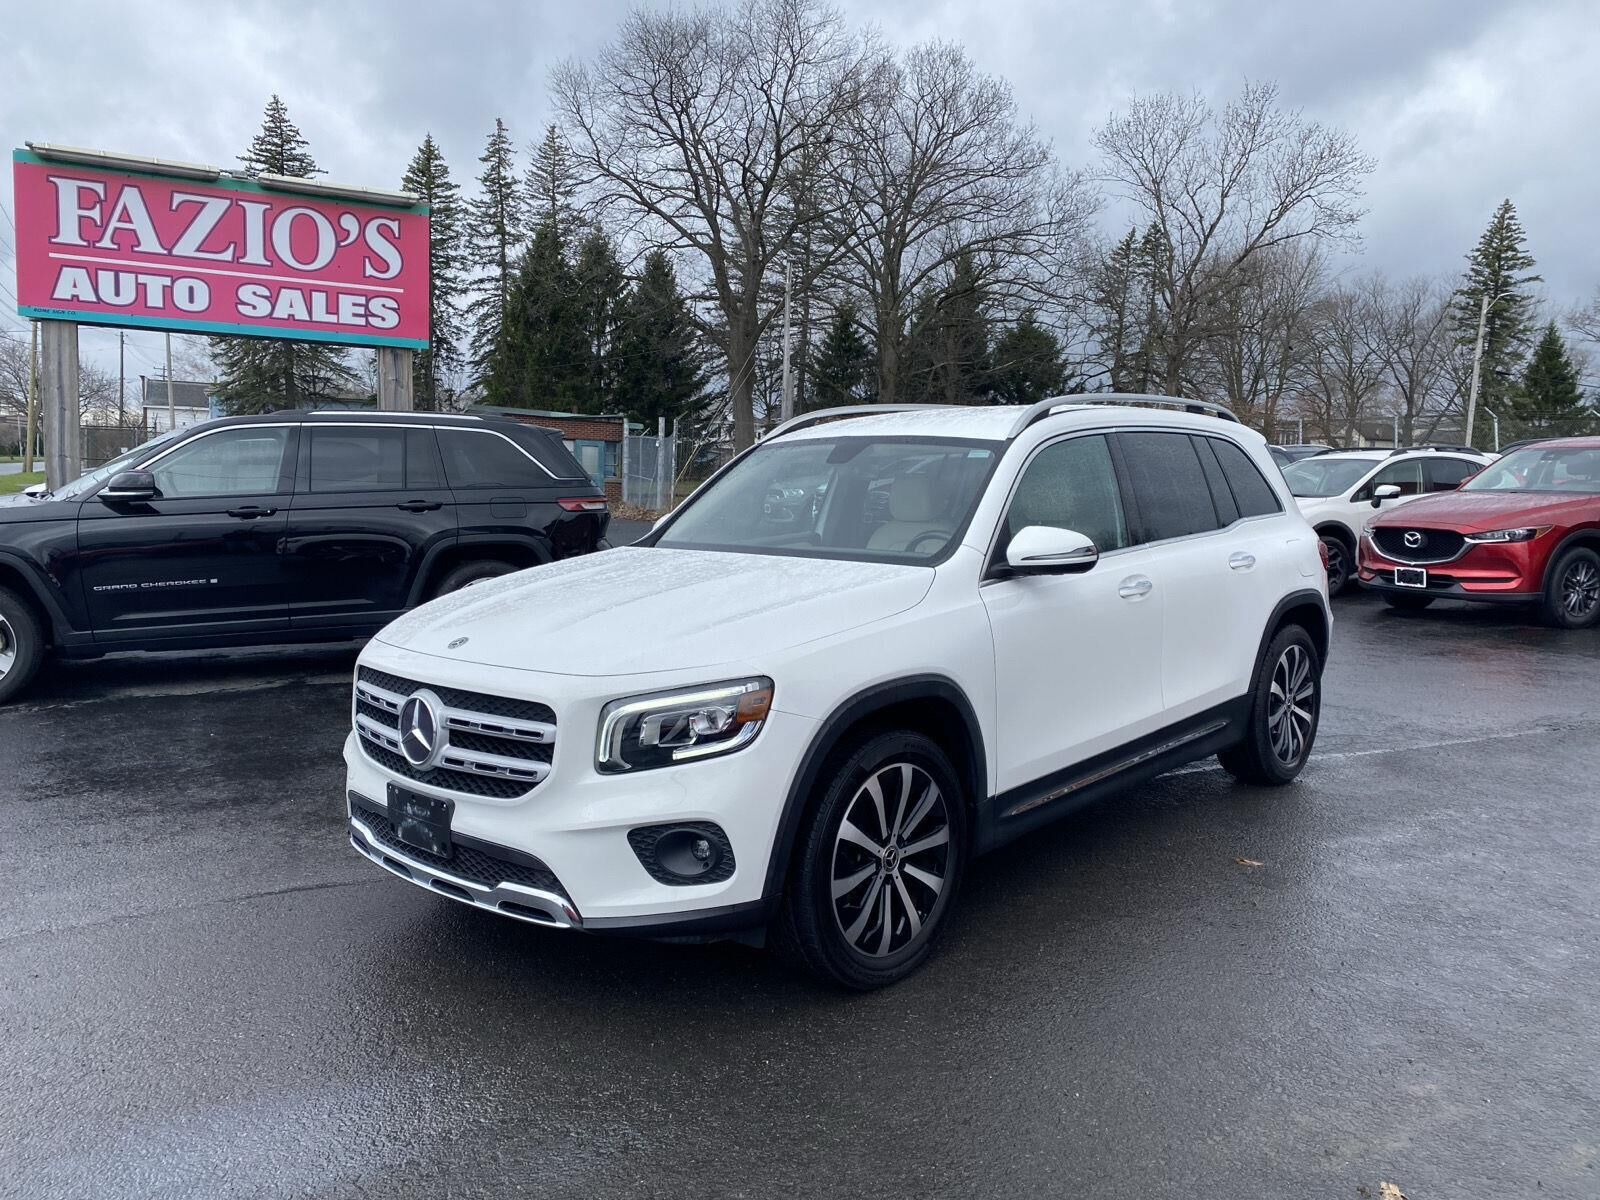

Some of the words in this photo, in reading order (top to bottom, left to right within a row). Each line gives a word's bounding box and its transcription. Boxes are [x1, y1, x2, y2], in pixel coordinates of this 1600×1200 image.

[48, 175, 404, 281] FAZIO'S
[51, 265, 210, 313] AUTO
[236, 283, 401, 330] SALES
[93, 583, 138, 591] GRAND
[141, 579, 207, 588] CHEROKEE
